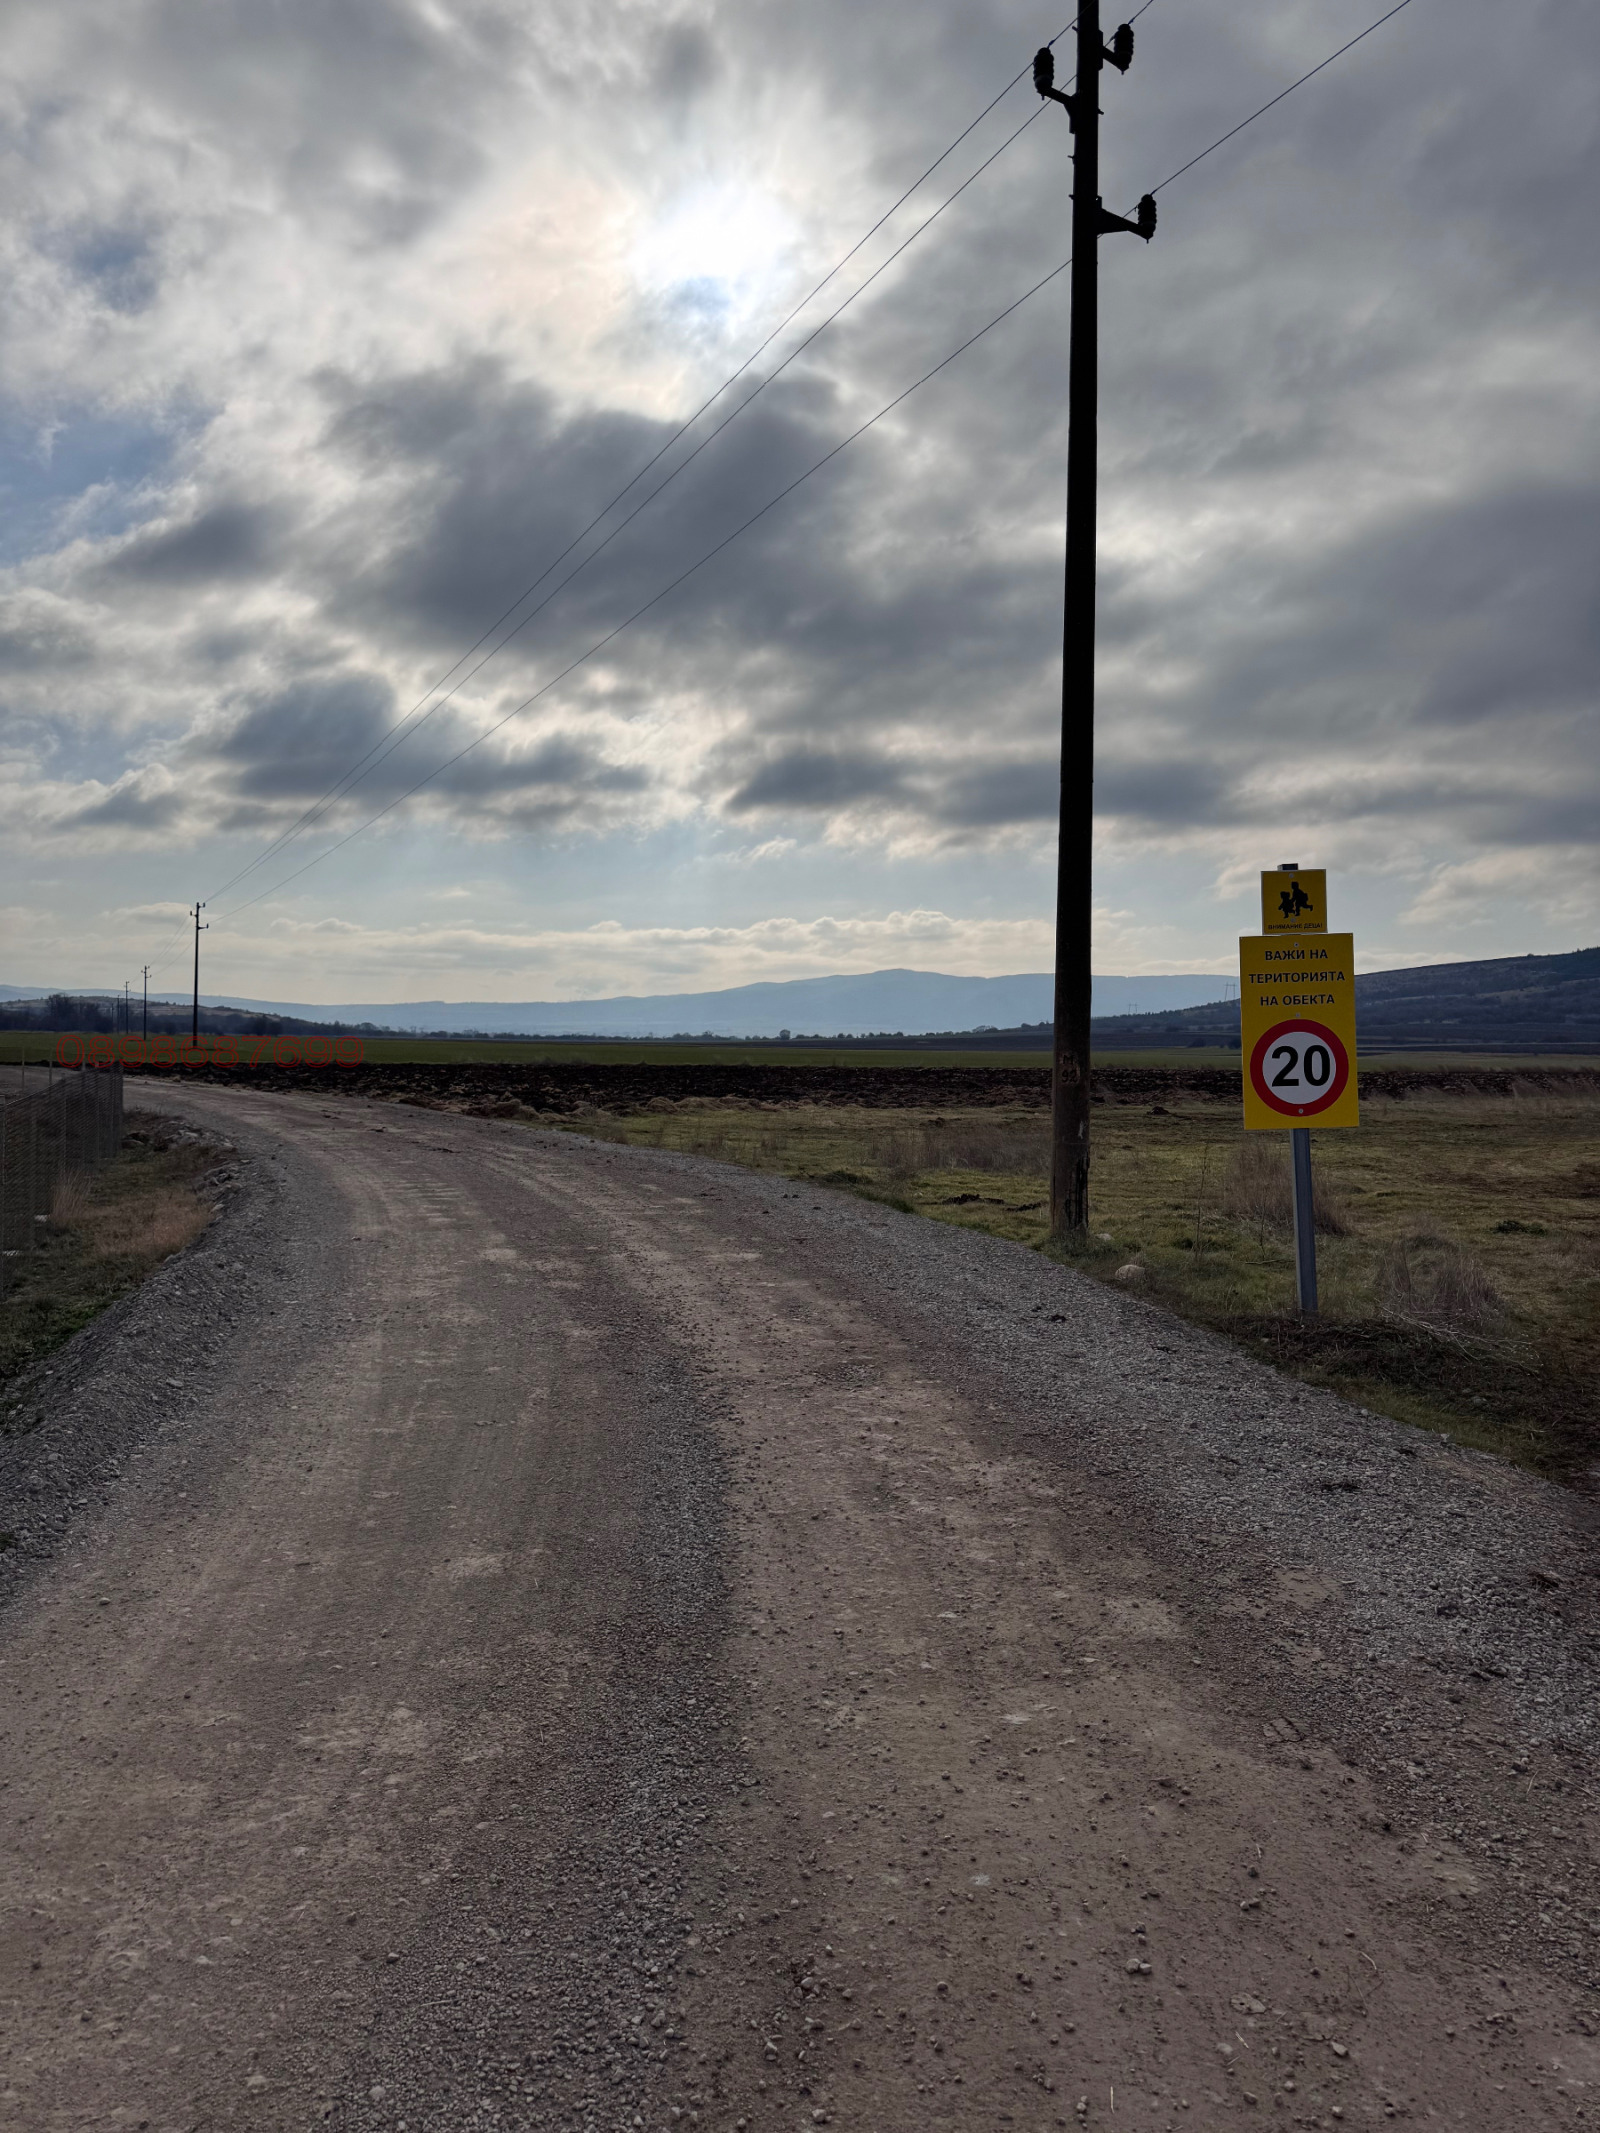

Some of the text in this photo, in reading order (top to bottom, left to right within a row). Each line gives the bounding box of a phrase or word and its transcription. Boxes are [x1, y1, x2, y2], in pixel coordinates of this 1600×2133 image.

[1265, 949, 1328, 961] ВАЖИ НА
[1249, 971, 1345, 984] ТЕРИТОРИЯТА
[1260, 994, 1335, 1006] НА ОБЕКТА
[1271, 1044, 1330, 1087] 20
